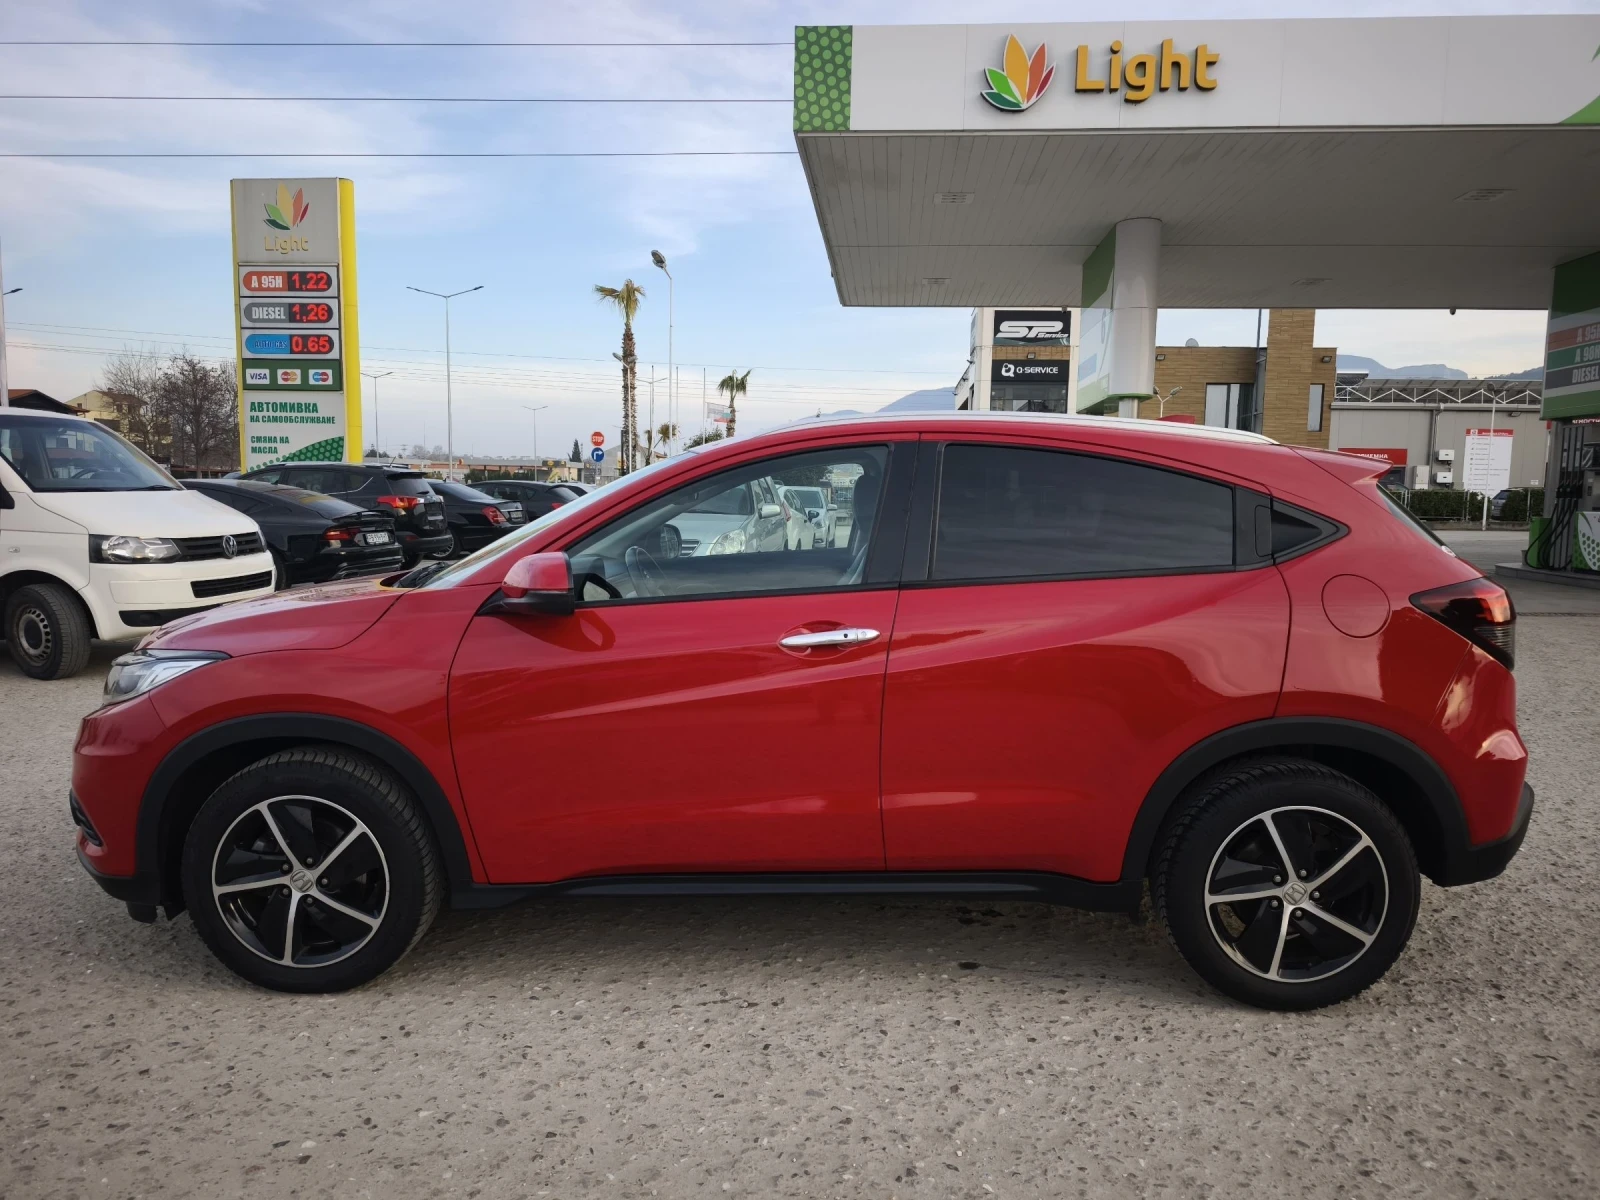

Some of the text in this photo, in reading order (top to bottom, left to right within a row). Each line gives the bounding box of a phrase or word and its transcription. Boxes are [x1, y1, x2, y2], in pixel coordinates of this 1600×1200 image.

[1075, 38, 1220, 103] Light
[264, 235, 309, 254] Light
[251, 275, 259, 288] A
[252, 307, 286, 319] DIESEL
[995, 321, 1064, 338] SP
[249, 372, 268, 380] VISA
[1571, 365, 1600, 384] DIESEL
[249, 401, 319, 414] АВТОМИВКА
[249, 415, 336, 425] НА САМООБСЛУЖВАНЕ
[250, 435, 290, 444] СМЯНА НА
[592, 435, 604, 443] STOP
[251, 446, 278, 454] МАСЛА
